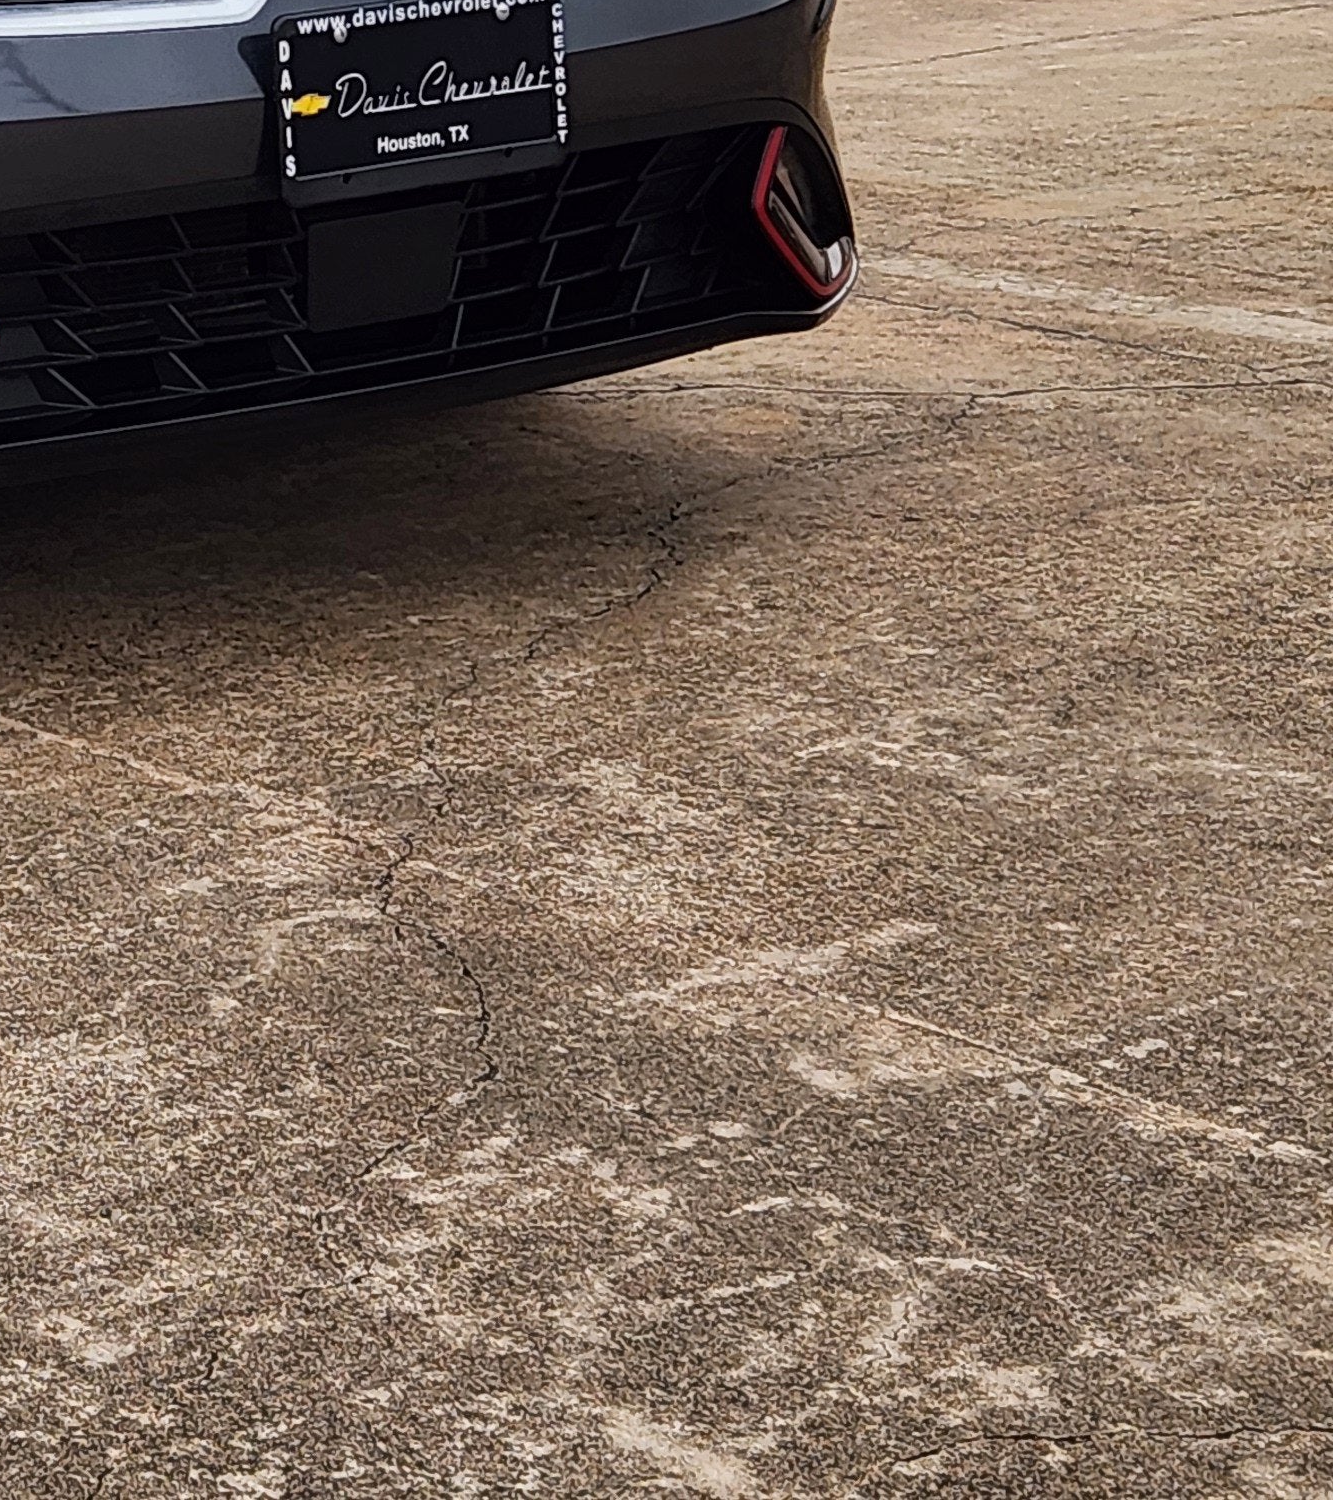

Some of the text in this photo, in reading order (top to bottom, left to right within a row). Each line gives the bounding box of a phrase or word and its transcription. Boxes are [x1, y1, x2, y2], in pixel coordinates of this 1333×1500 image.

[278, 40, 297, 178] DAVIS
[335, 60, 553, 118] Davis Chevrolet
[550, 3, 569, 144] CHEVROLET
[377, 124, 470, 155] Houston, TX
